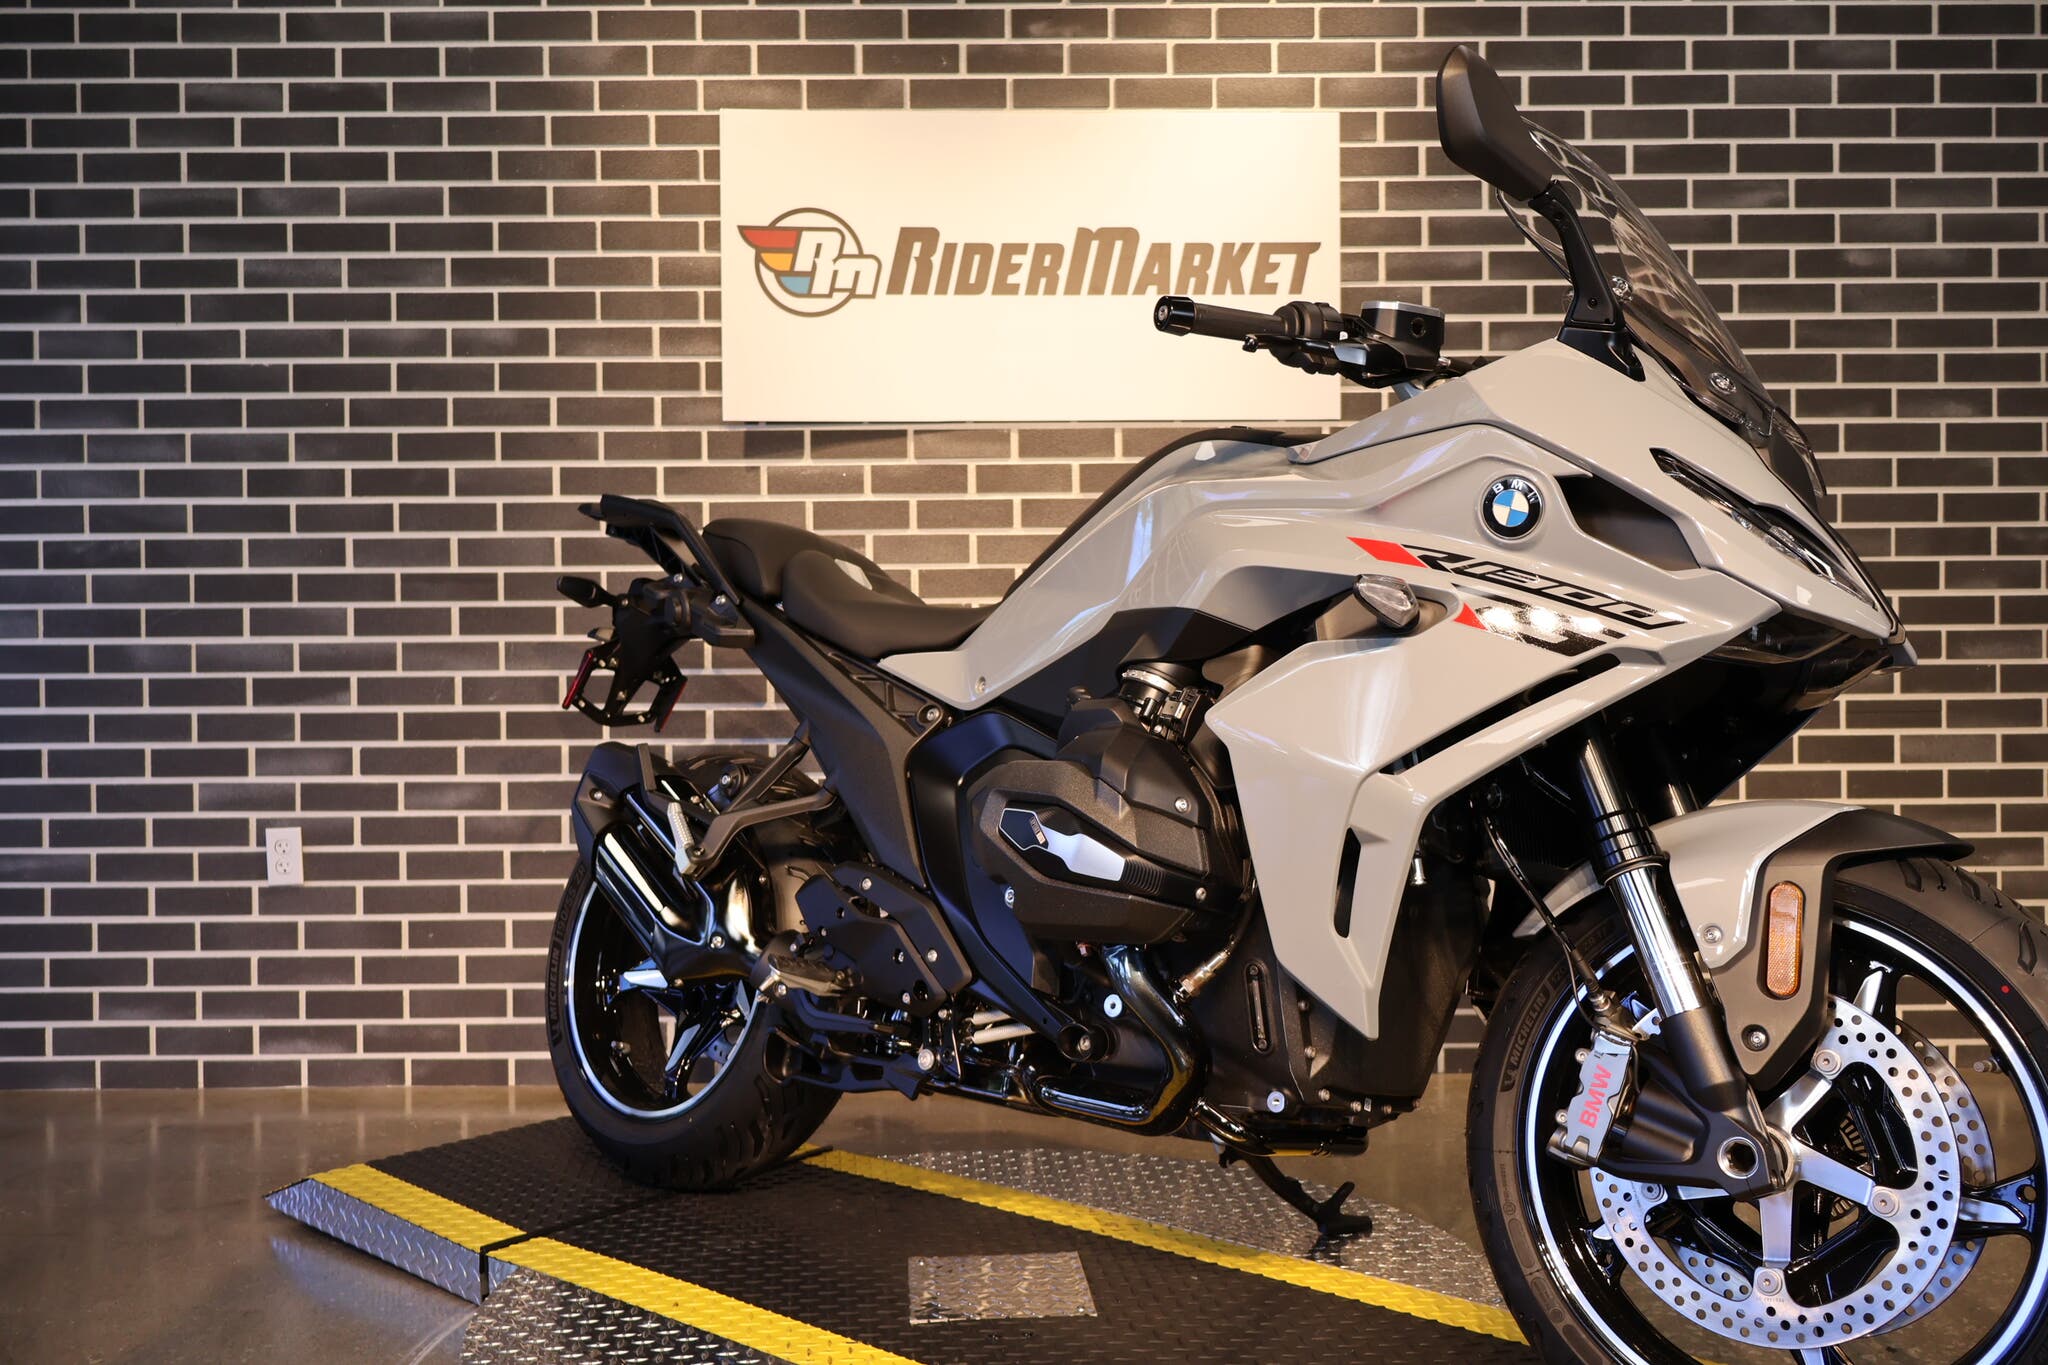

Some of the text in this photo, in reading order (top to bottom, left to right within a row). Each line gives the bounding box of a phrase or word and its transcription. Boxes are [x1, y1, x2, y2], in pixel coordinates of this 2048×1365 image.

[1492, 478, 1539, 504] BMW
[1511, 992, 1548, 1066] MICHELIN
[1579, 1063, 1612, 1128] BMW
